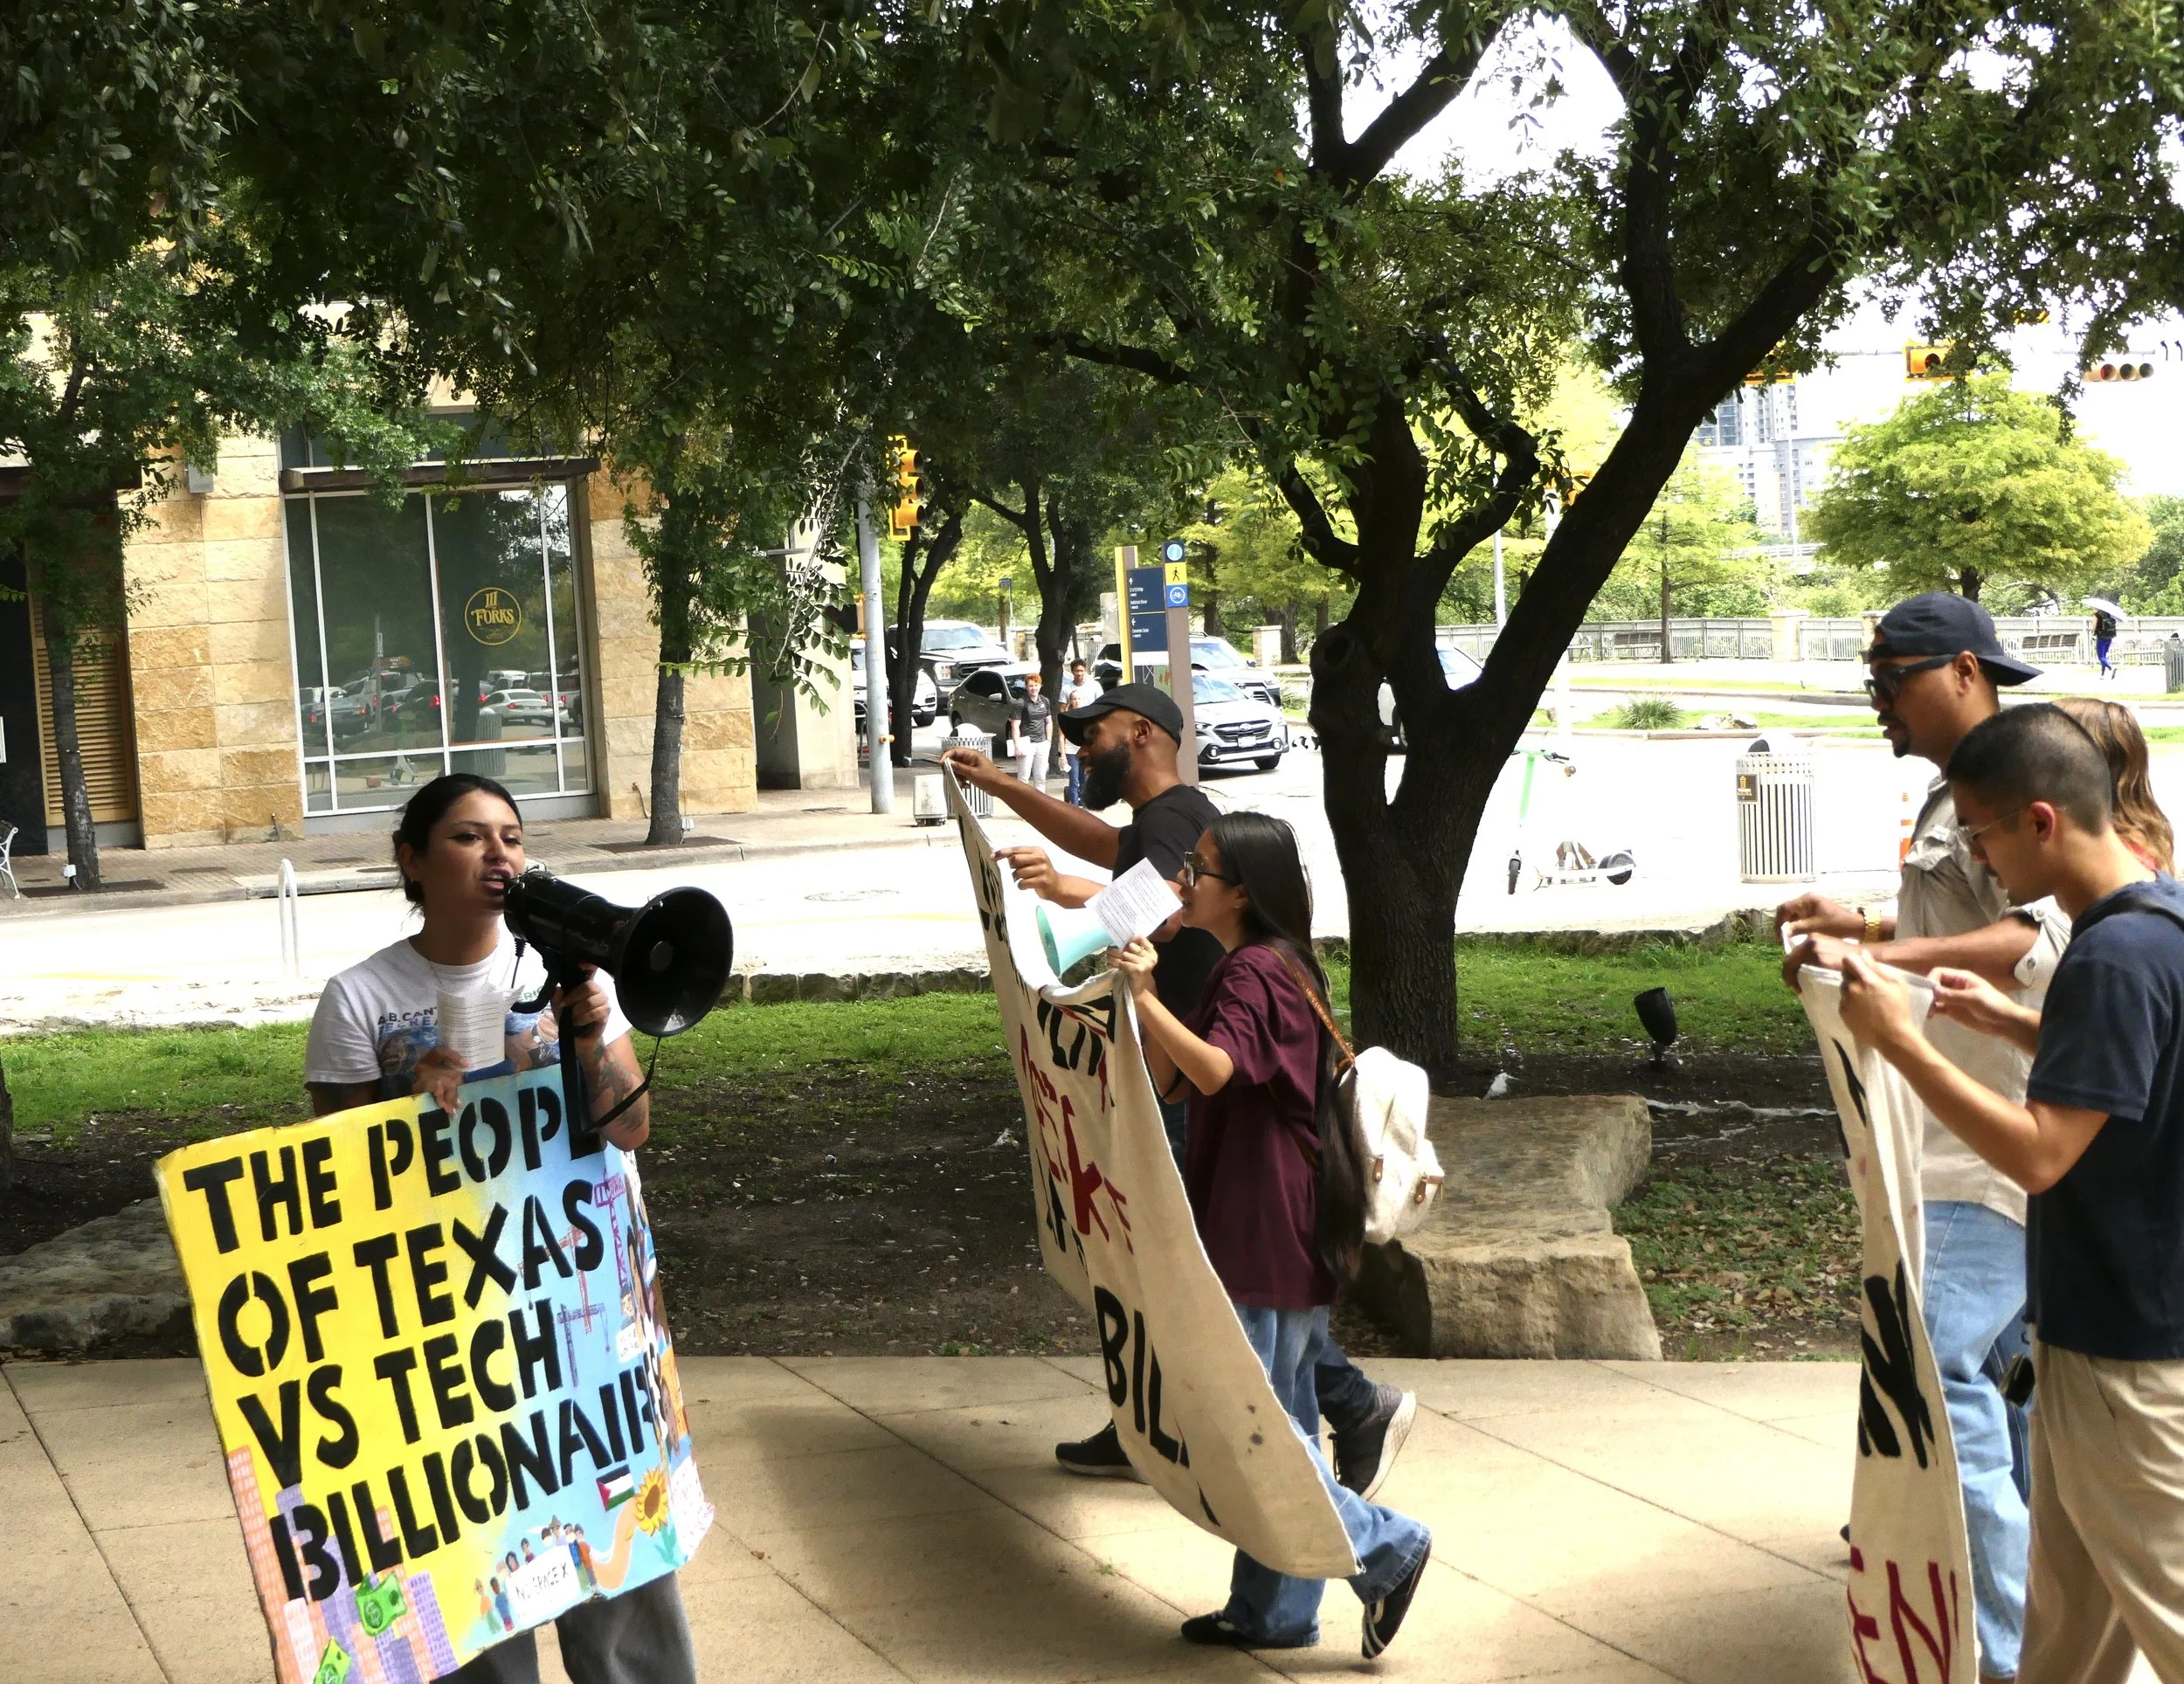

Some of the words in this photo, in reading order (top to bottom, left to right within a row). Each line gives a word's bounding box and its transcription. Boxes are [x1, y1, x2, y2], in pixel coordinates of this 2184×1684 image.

[470, 608, 515, 627] FORKS
[183, 1136, 342, 1254] THE
[367, 1086, 606, 1211] PEOPL
[218, 1252, 340, 1377] OF
[354, 1178, 605, 1340] TEXAS
[238, 1364, 360, 1489] VS
[374, 1297, 563, 1446] TECH
